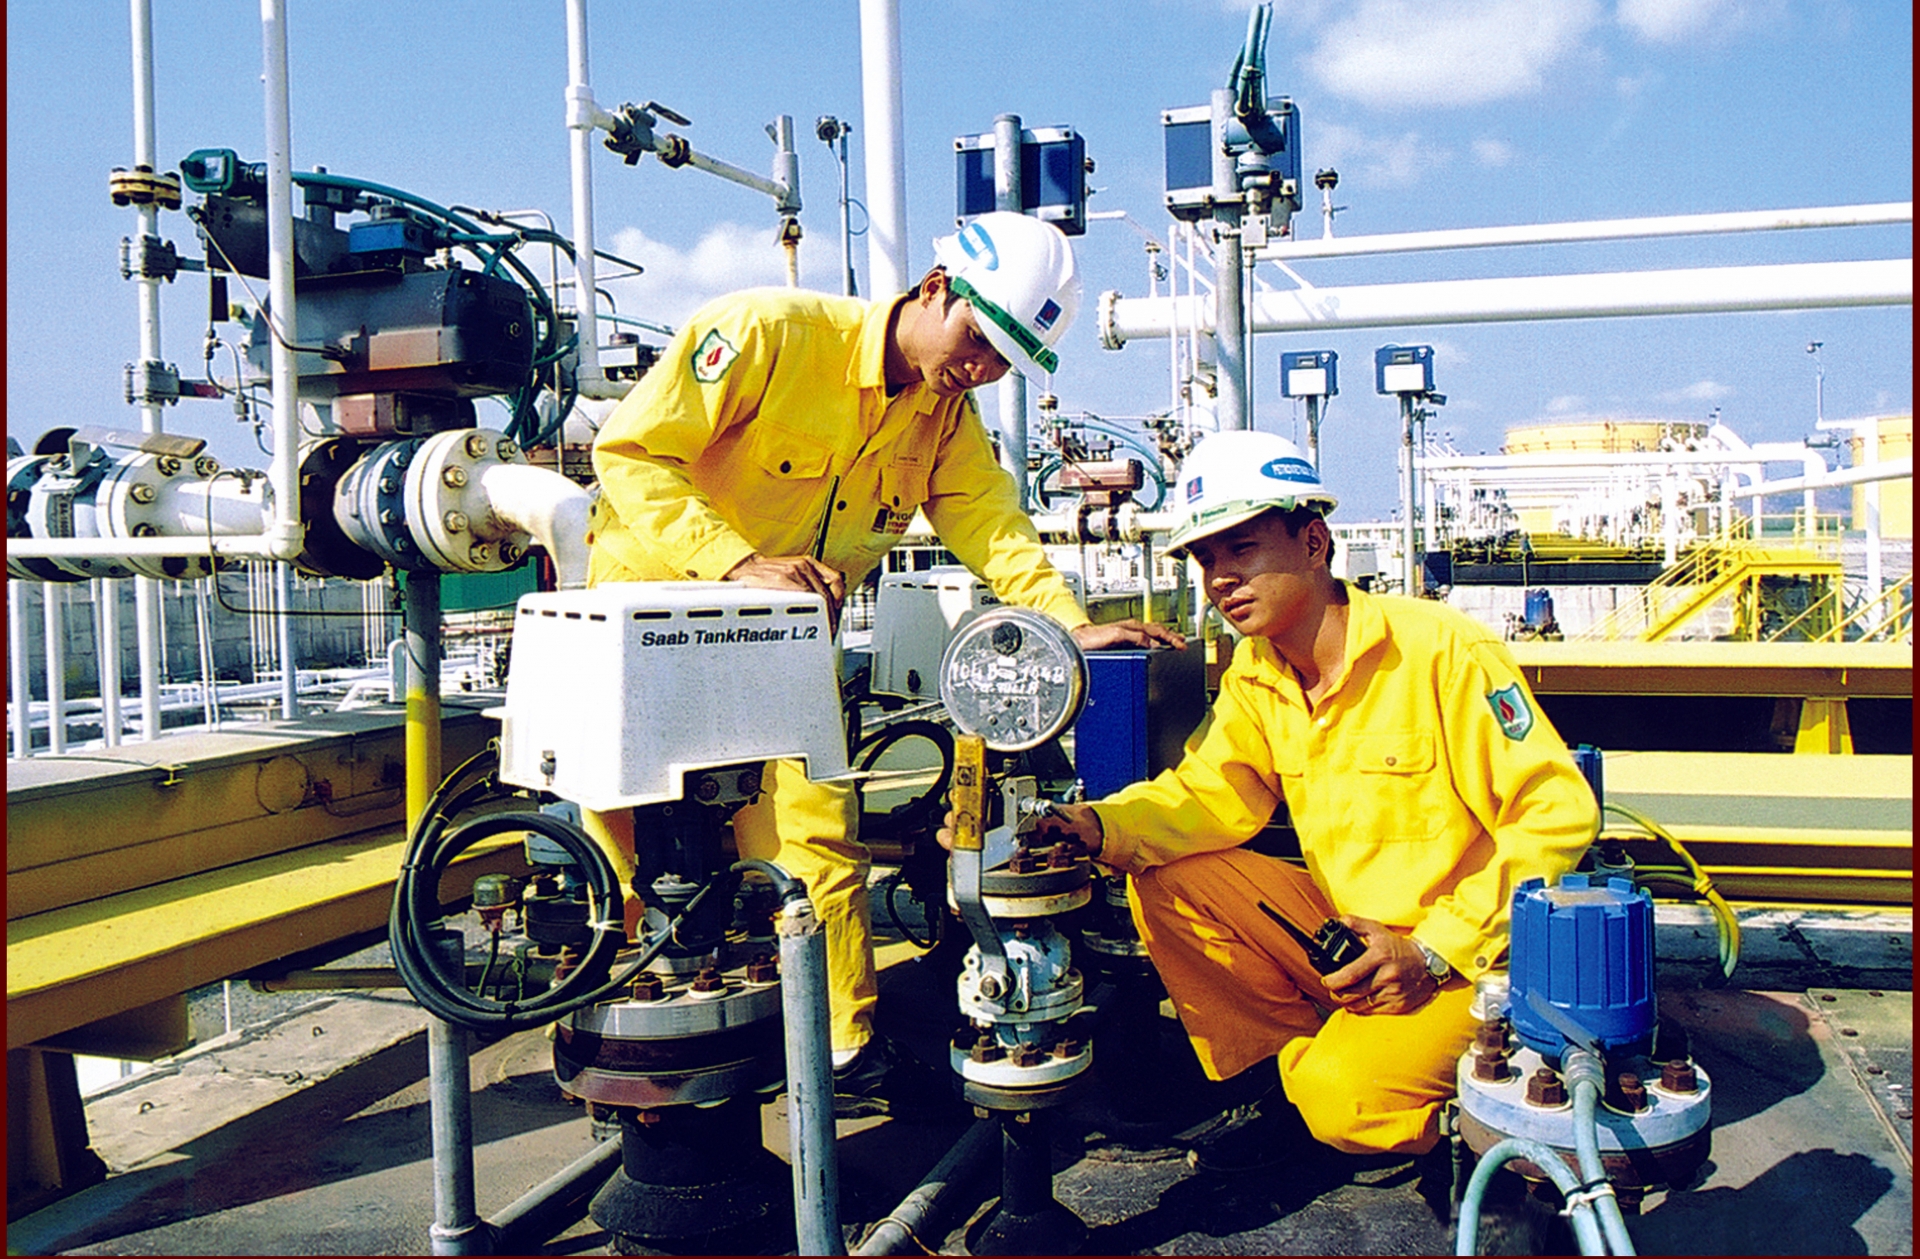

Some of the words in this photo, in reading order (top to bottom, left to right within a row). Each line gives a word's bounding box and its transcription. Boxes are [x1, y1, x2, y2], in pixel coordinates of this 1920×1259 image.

[981, 595, 1001, 606] Saa
[641, 630, 690, 647] Saab
[694, 626, 788, 645] TankRadar
[791, 625, 819, 641] L/2
